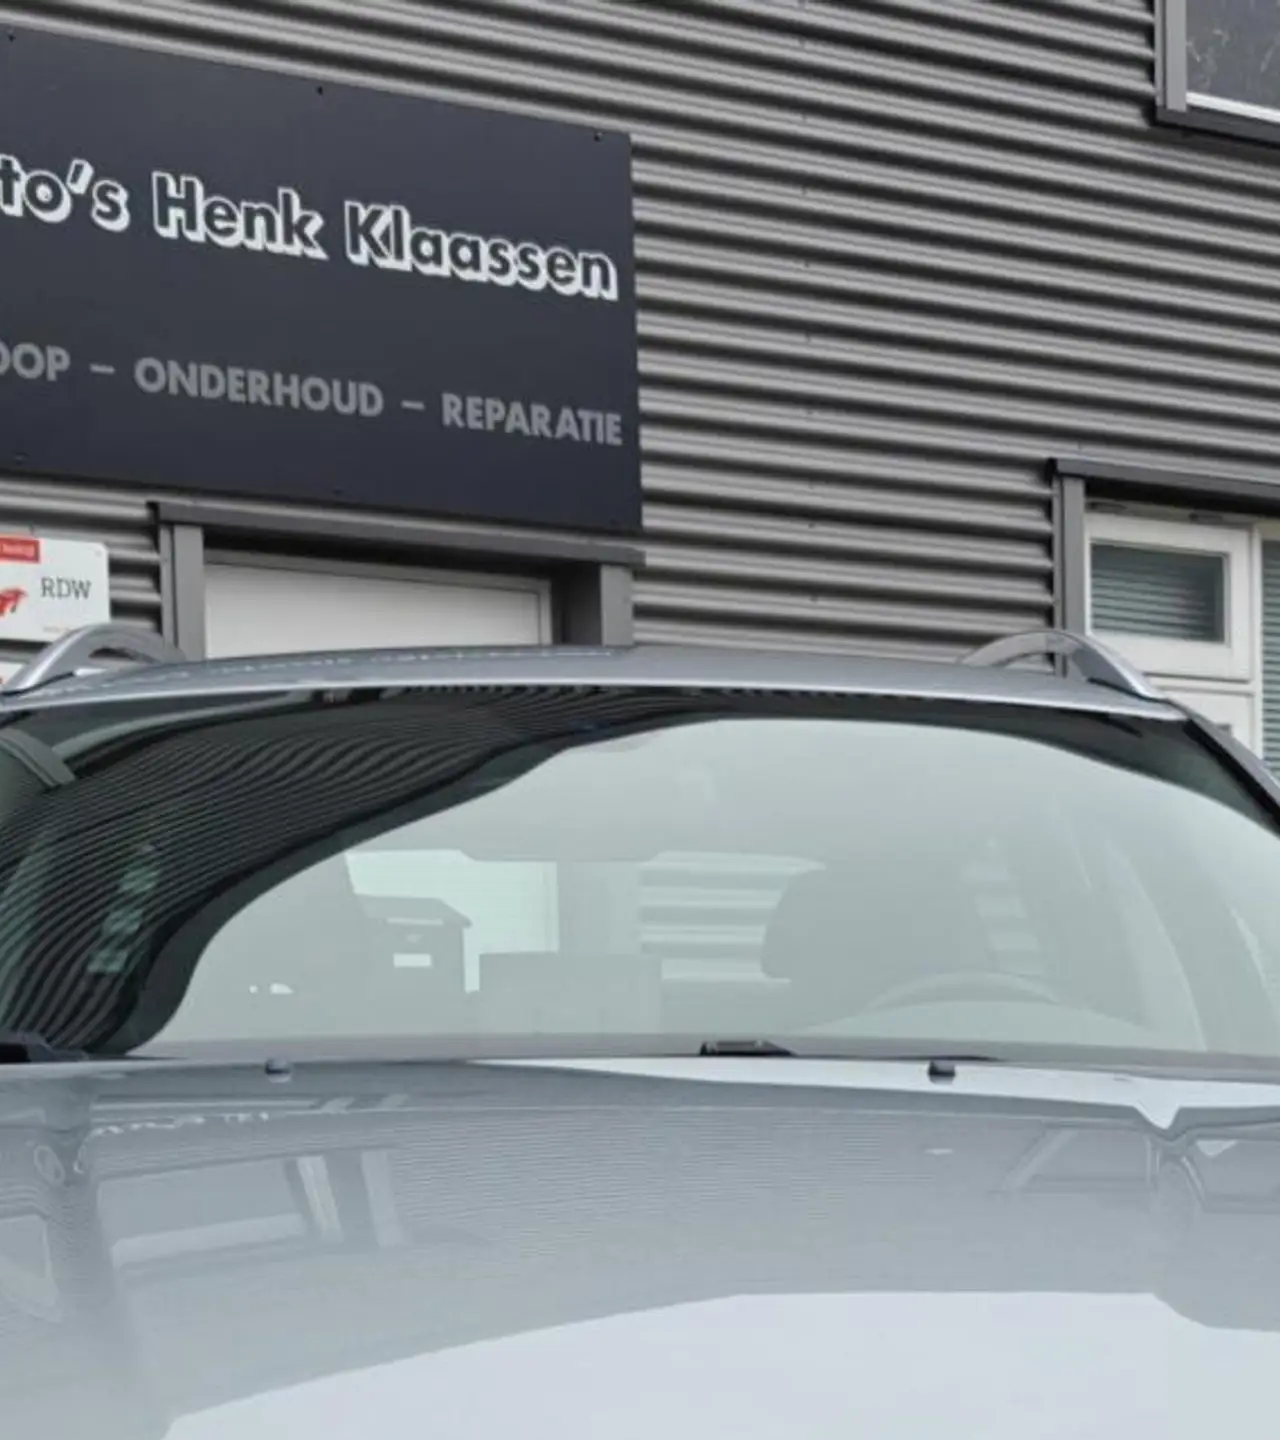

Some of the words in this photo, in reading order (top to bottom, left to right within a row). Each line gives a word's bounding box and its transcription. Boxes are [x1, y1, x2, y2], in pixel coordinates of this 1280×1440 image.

[152, 171, 329, 261] Henk
[344, 200, 618, 301] Klaassen
[134, 357, 383, 417] ONDERHOUD
[442, 392, 623, 446] REPARATIE
[40, 577, 92, 600] RDW
